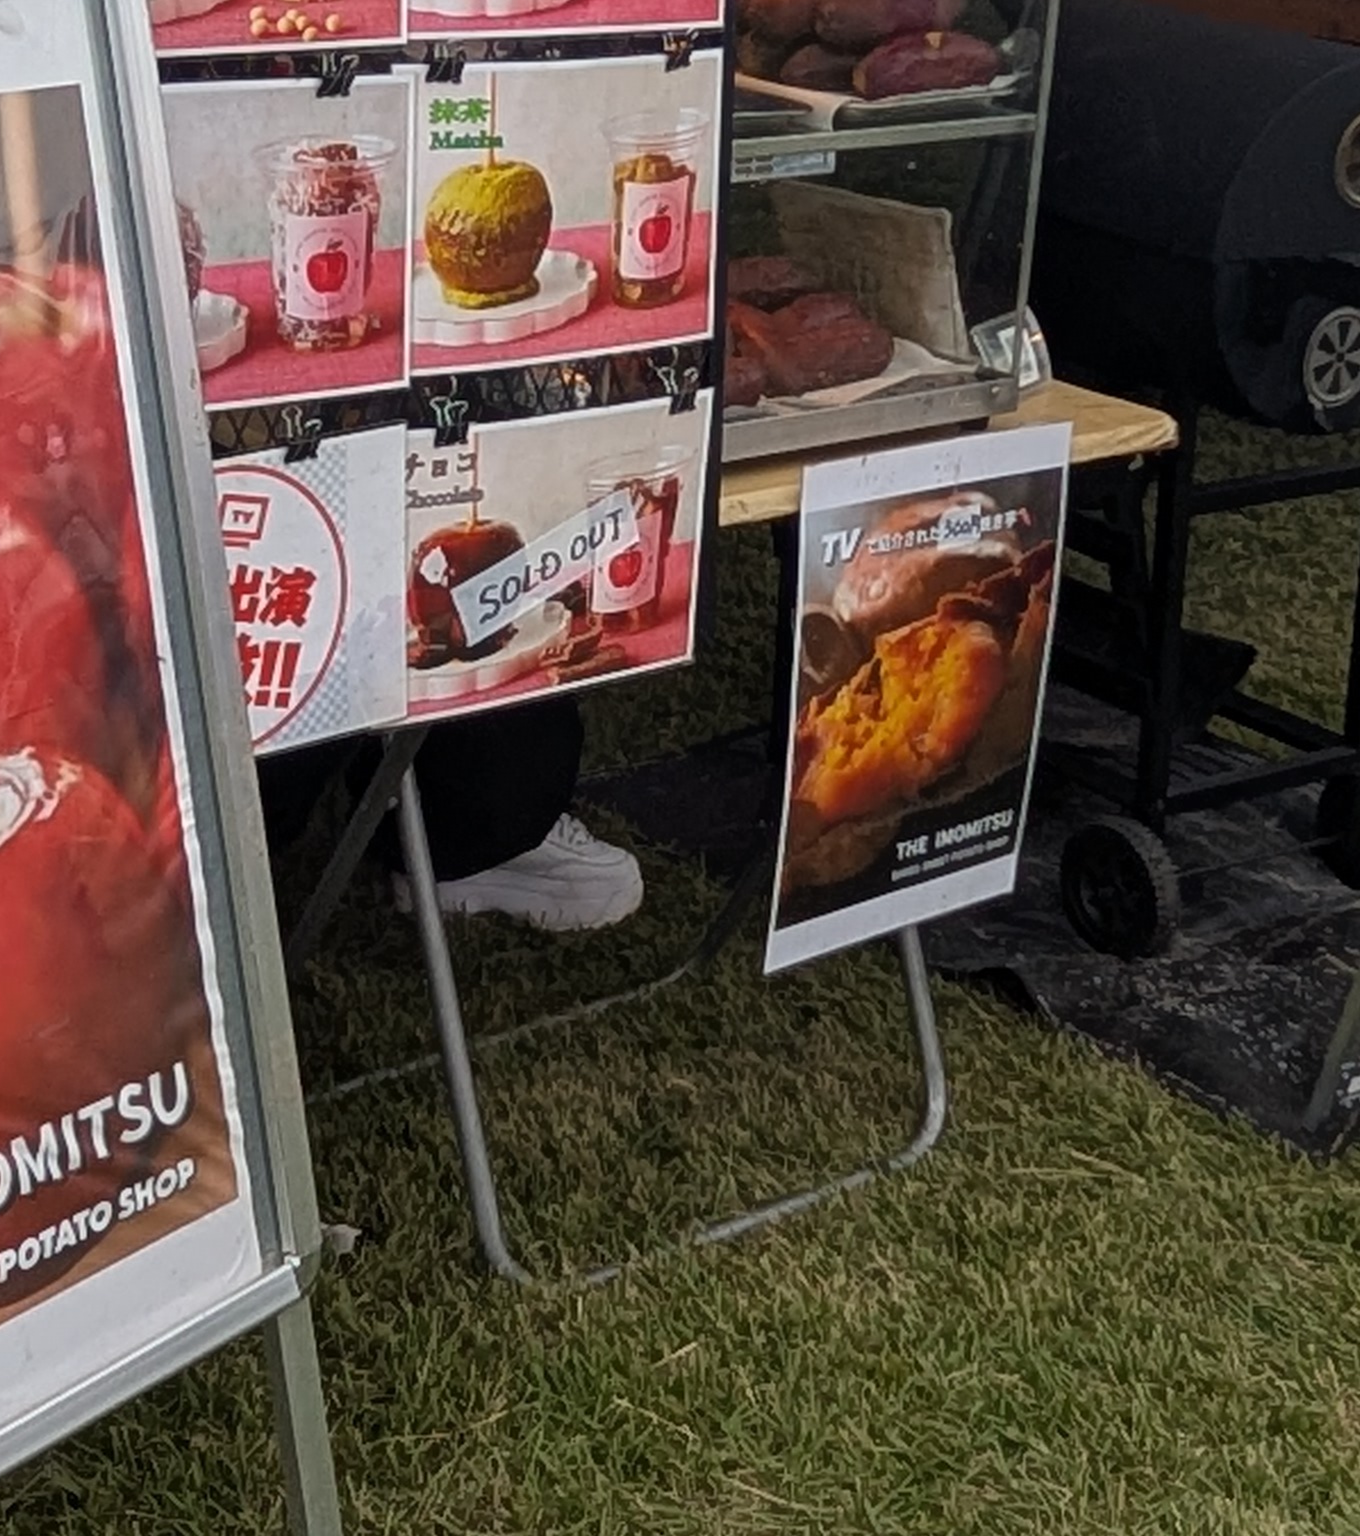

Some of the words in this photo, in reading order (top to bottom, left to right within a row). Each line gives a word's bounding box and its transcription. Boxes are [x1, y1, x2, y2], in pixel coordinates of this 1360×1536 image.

[429, 97, 492, 124] 抹茶
[428, 129, 504, 151] Matcha
[478, 550, 563, 625] SOLD
[569, 507, 624, 561] OUT
[820, 527, 864, 566] TV
[895, 834, 929, 862] THE
[934, 807, 1015, 850] IMOMITSU
[116, 1157, 196, 1221] SHOP
